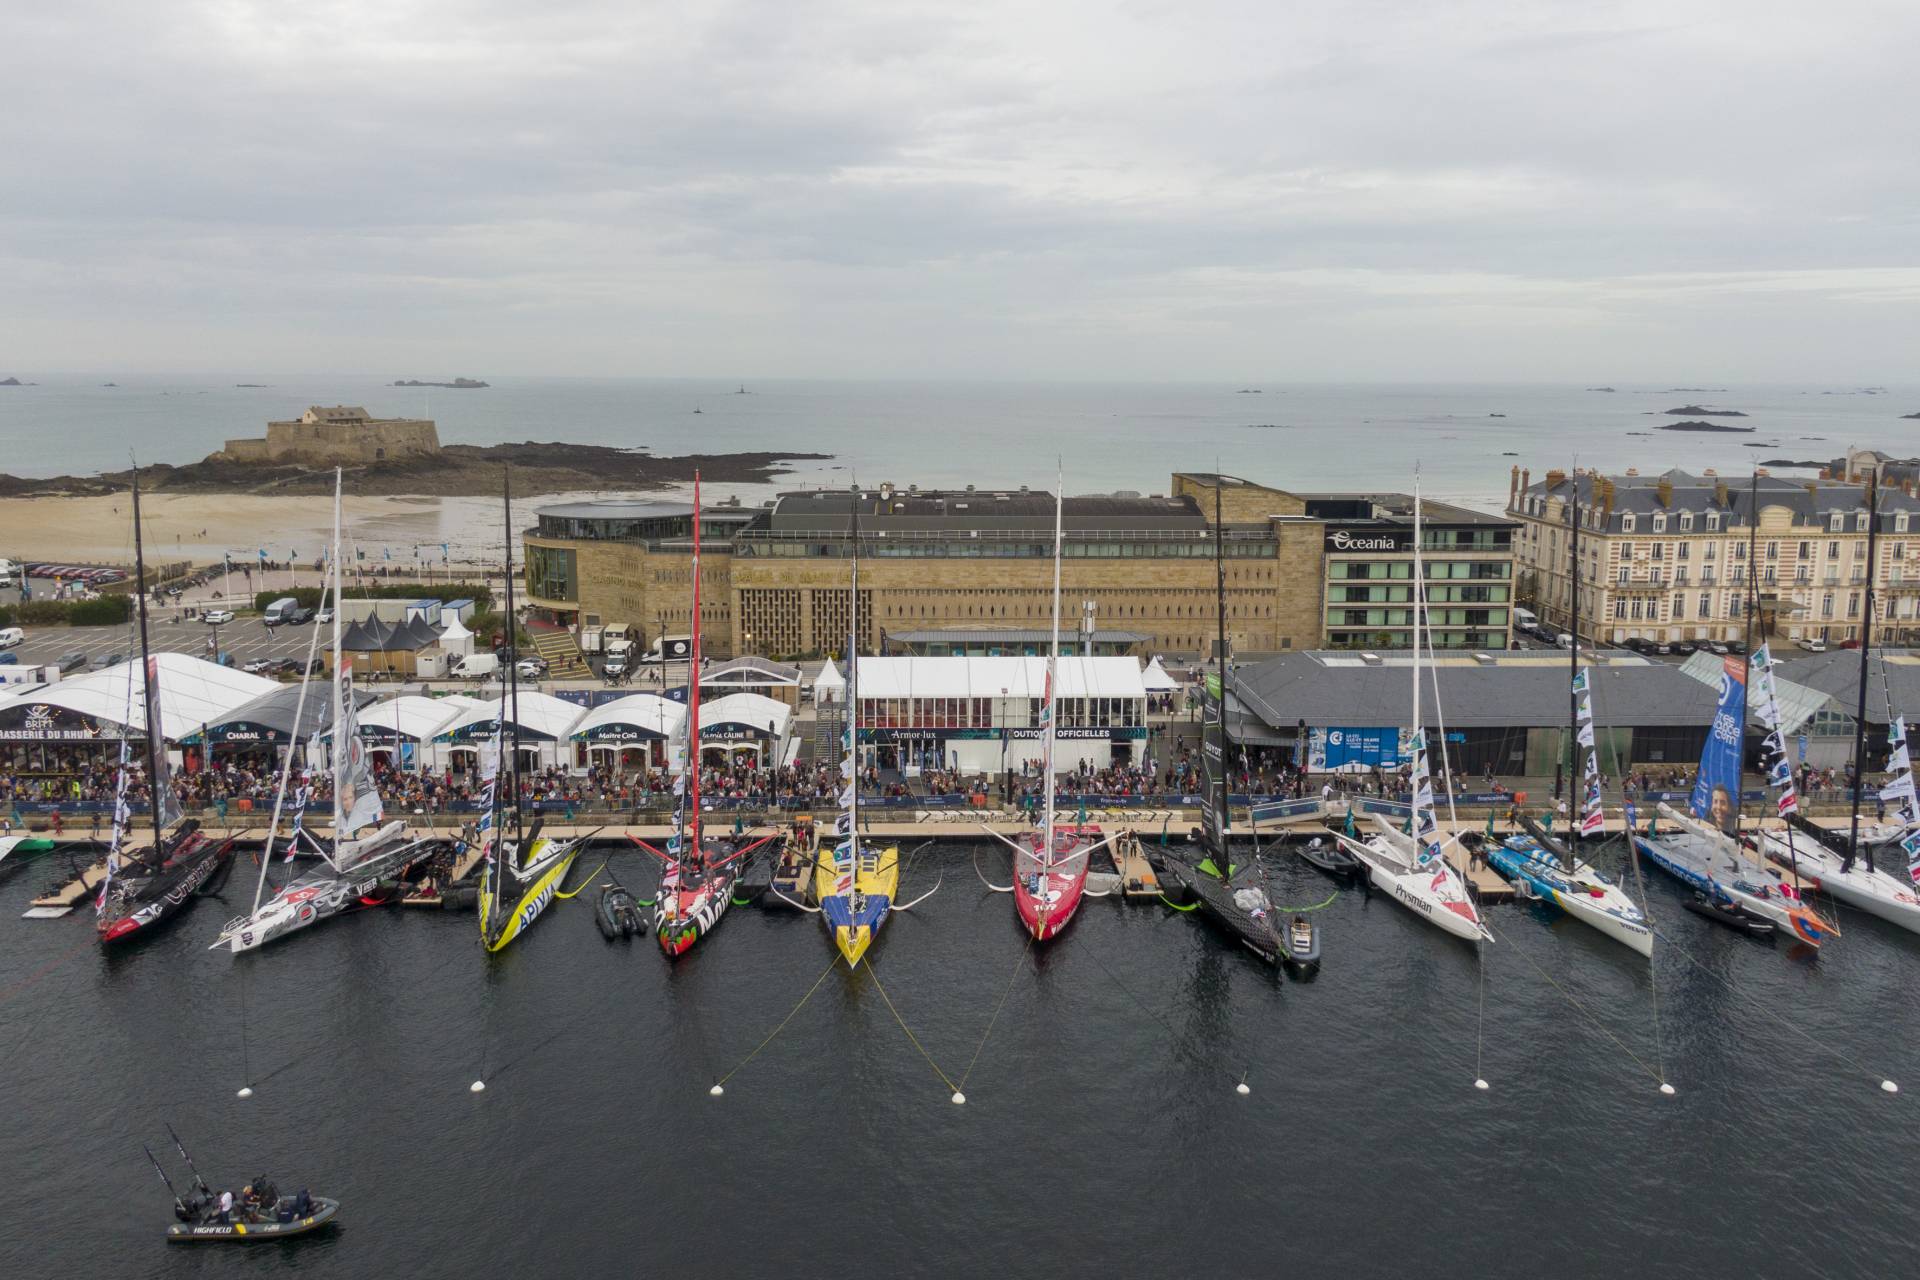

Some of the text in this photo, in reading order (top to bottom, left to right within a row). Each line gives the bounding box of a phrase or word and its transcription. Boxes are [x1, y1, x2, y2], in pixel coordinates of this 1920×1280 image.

[1327, 530, 1395, 550] Oceania
[48, 730, 60, 740] DU
[64, 730, 93, 740] RHUM
[1057, 729, 1110, 738] OFFICIELLES
[518, 883, 556, 929] APIVIA
[1395, 883, 1432, 914] Prysmian
[193, 1226, 232, 1234] HIGHFIELD
